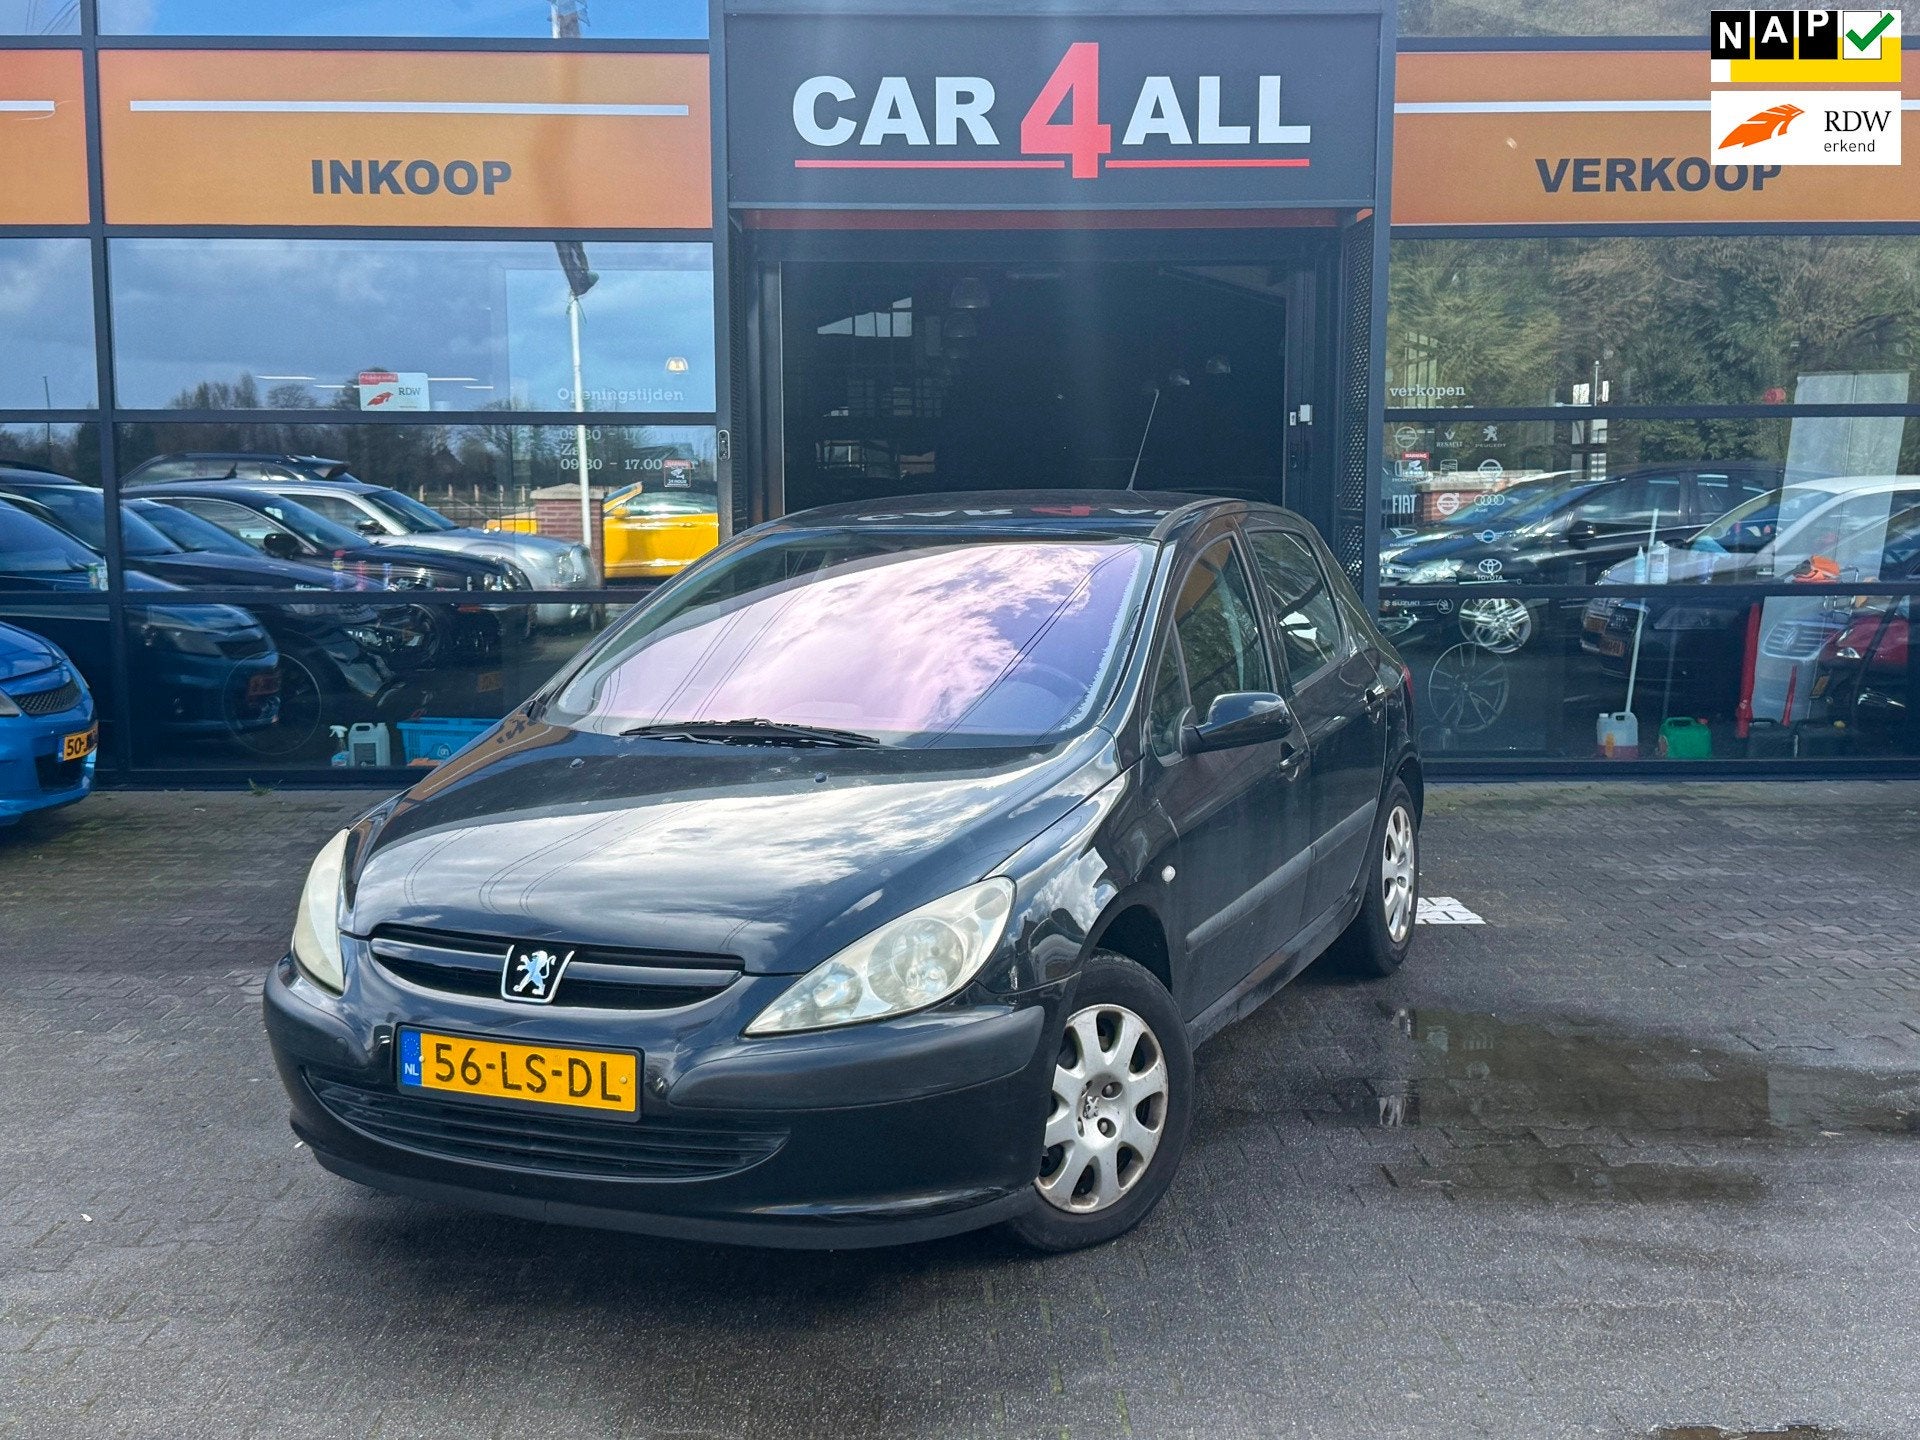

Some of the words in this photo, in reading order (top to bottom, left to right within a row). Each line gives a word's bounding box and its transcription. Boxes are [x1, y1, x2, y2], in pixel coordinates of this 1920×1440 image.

[792, 75, 1000, 146] CAR
[1020, 42, 1112, 178] 4
[1121, 75, 1311, 144] ALL
[311, 159, 512, 196] INKOOP
[1535, 157, 1782, 193] VERKOOP
[398, 387, 421, 396] RDW
[1390, 384, 1466, 399] verkopen
[560, 429, 602, 441] 0930
[560, 458, 603, 471] 0930
[624, 459, 662, 470] 17.00
[1392, 494, 1417, 514] FIAT
[404, 1063, 419, 1077] NL
[434, 1042, 622, 1103] 56-LS-DL
